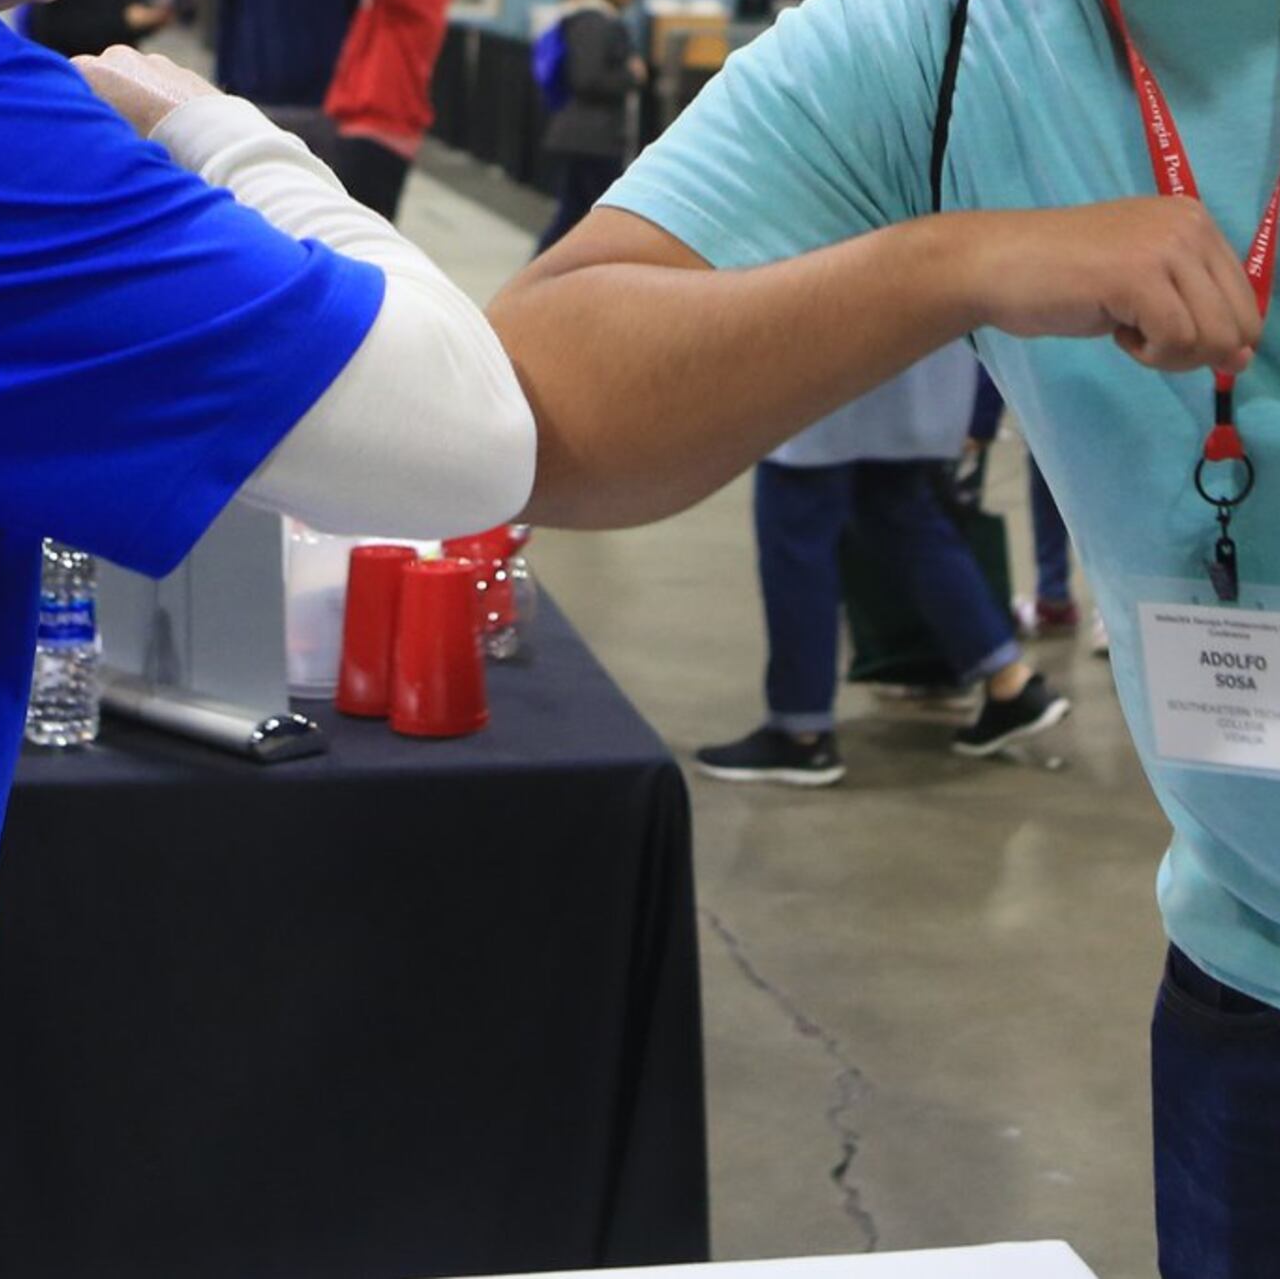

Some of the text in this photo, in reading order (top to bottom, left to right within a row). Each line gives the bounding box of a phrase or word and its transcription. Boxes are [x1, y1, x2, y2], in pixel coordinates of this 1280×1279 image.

[1163, 154, 1185, 197] Post
[1200, 650, 1267, 671] ADOLFO
[1215, 673, 1258, 691] SOSA
